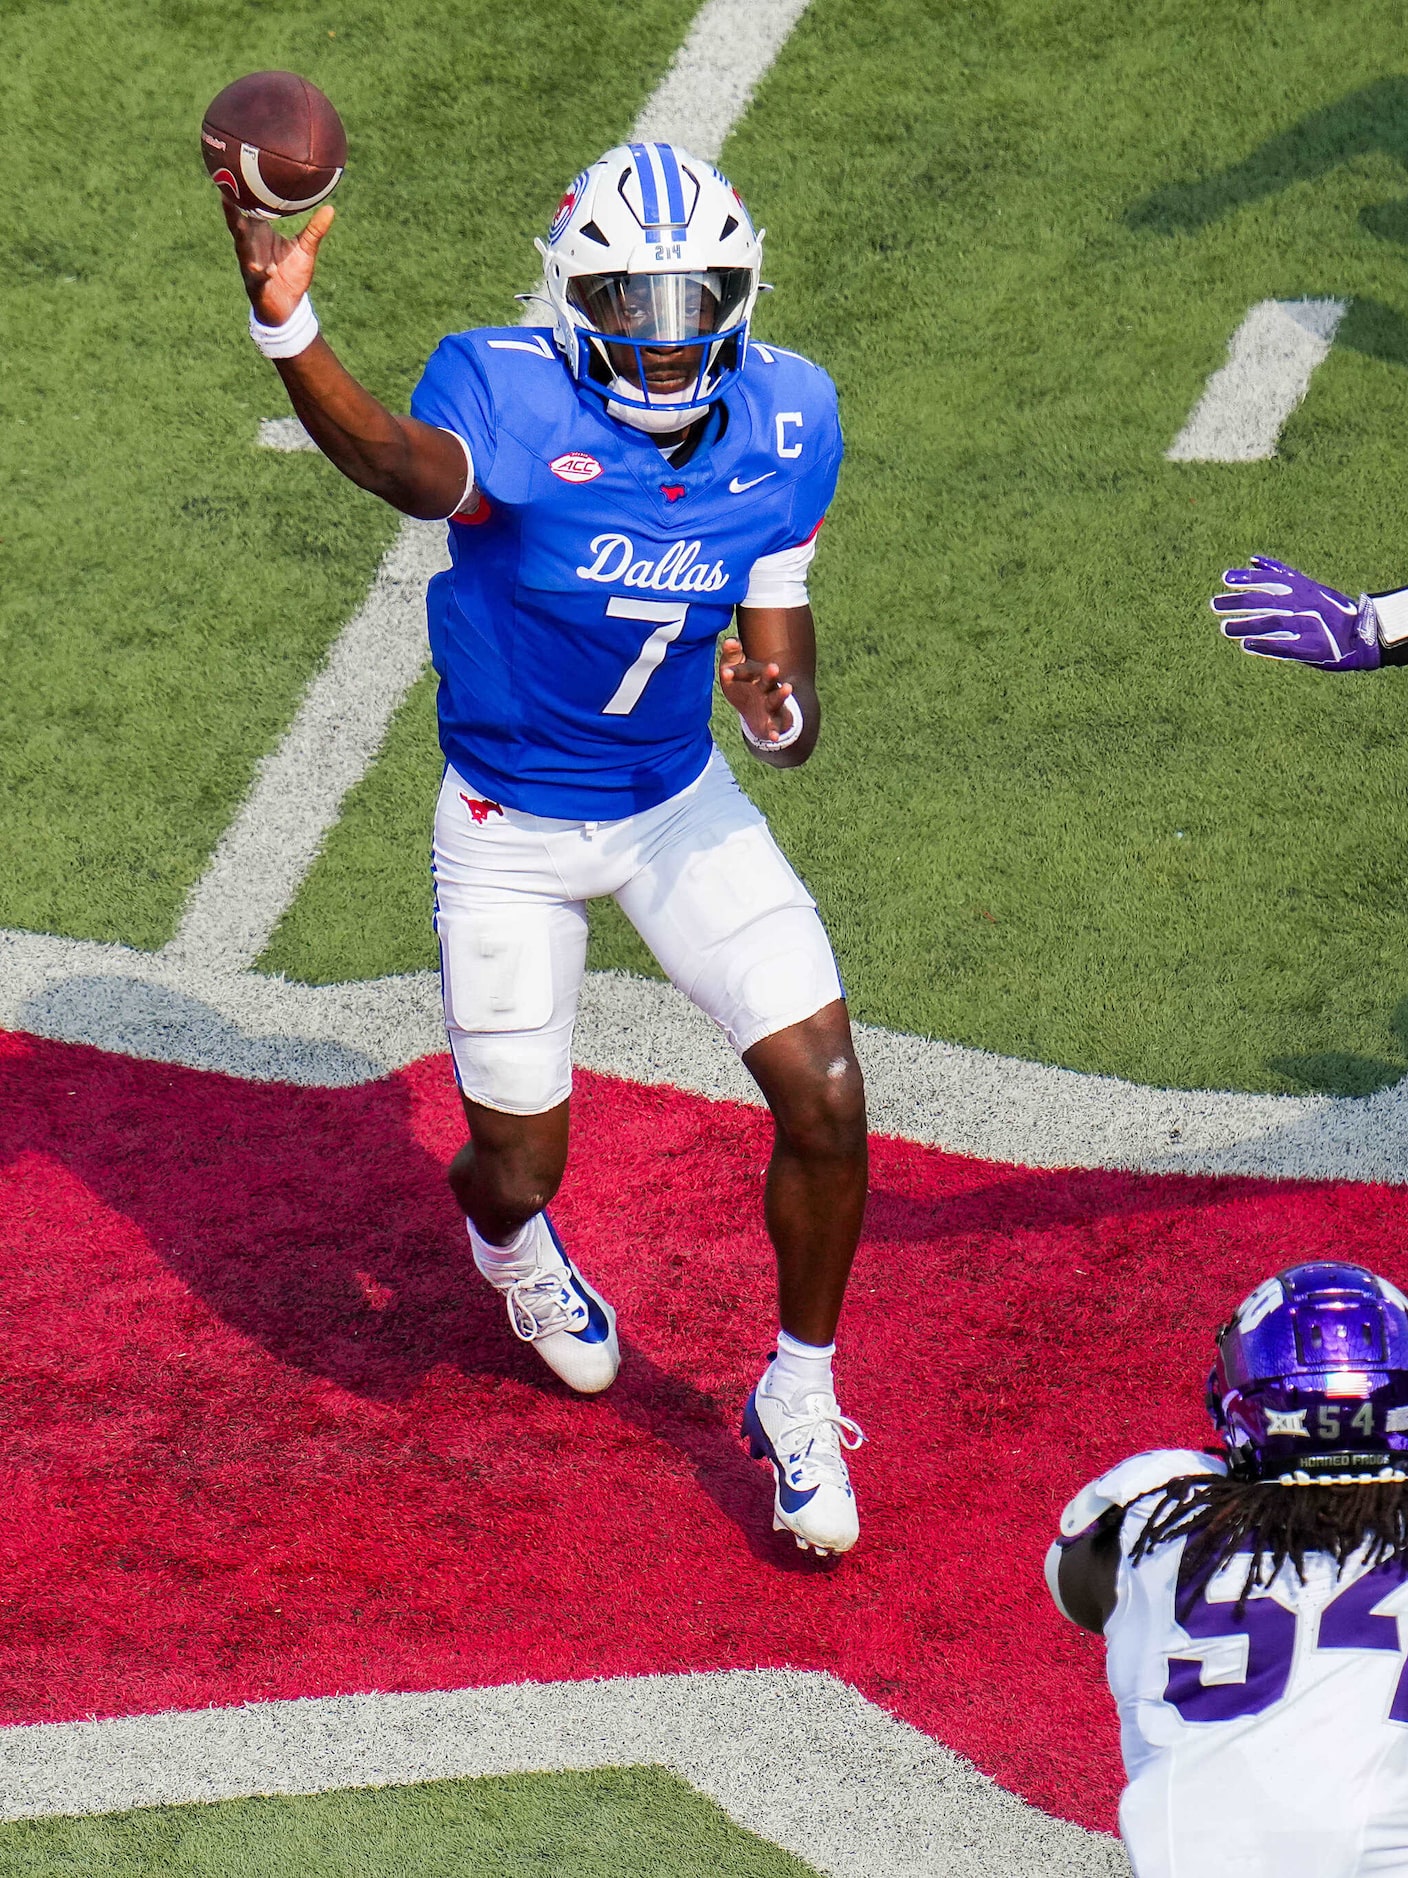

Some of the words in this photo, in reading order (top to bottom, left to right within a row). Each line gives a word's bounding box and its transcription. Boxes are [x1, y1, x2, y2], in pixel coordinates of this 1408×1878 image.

[655, 244, 682, 261] 214
[774, 411, 804, 459] C
[558, 460, 596, 473] ACC
[575, 532, 731, 592] Dallas
[601, 595, 691, 716] 7
[1317, 1402, 1376, 1440] 54
